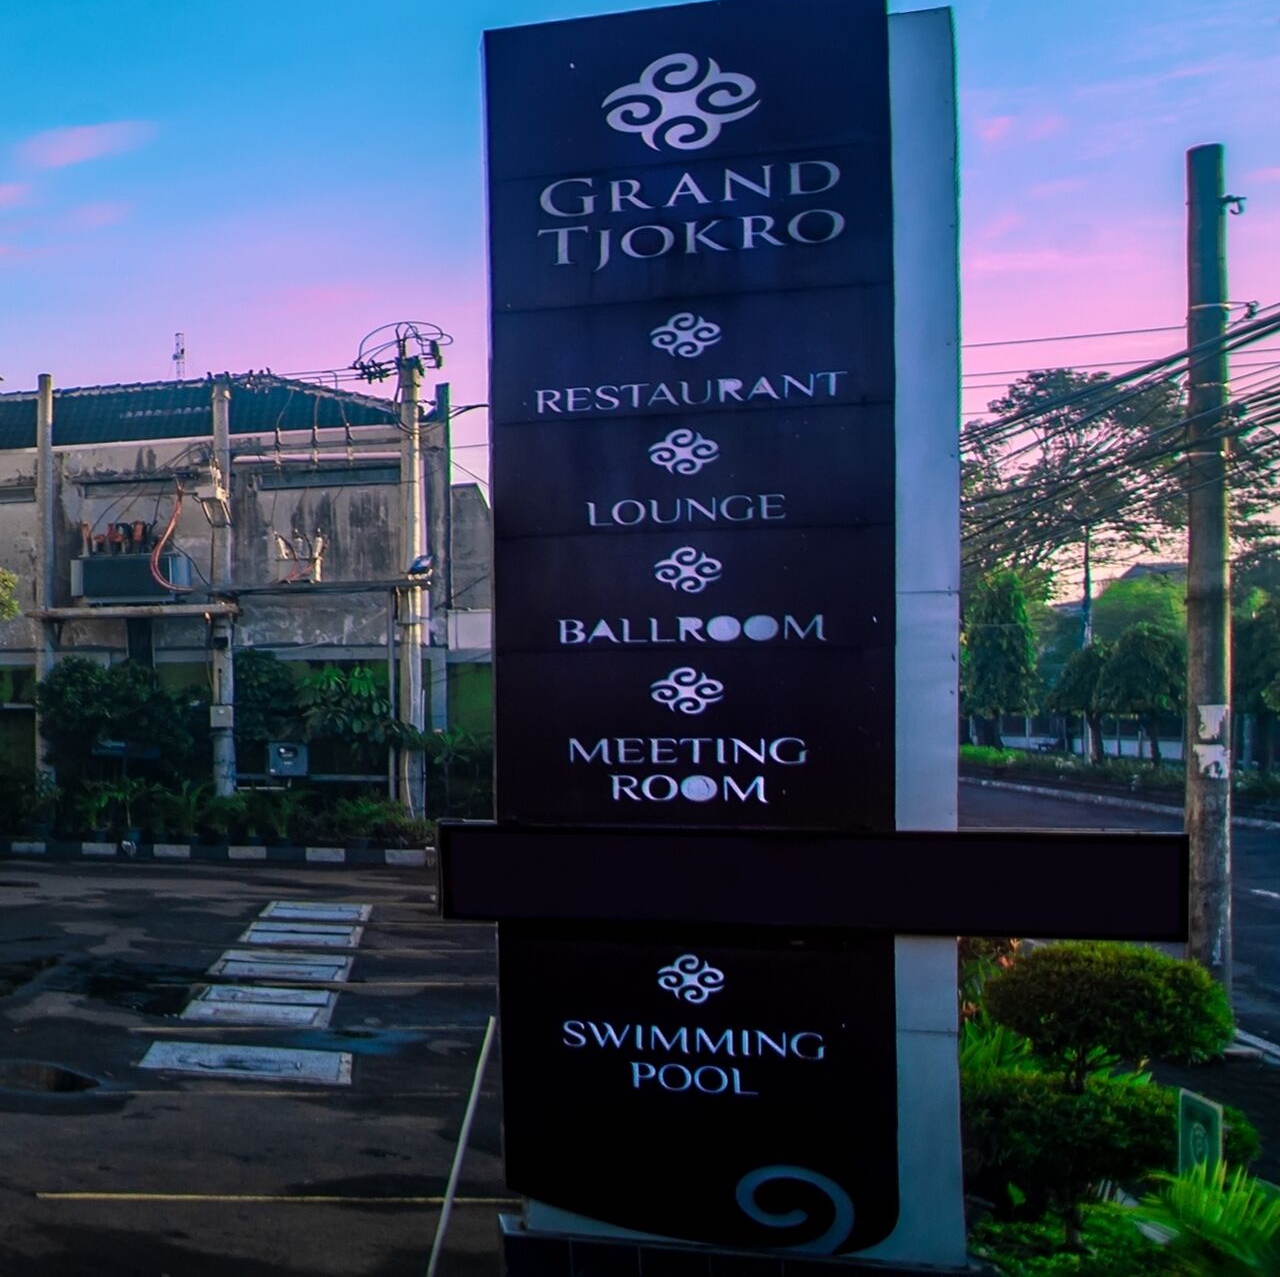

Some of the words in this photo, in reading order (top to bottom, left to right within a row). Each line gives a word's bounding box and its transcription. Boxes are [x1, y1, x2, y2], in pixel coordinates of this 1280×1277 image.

[539, 160, 842, 218] GRAND
[537, 209, 846, 271] TJOKRO
[535, 371, 848, 414] RESTAURANT
[586, 494, 787, 527] LOUNGE
[557, 614, 827, 644] BALLROOM
[569, 736, 808, 766] MEETING
[611, 773, 769, 804] ROOM
[563, 1020, 825, 1060] SWIMMING
[630, 1061, 759, 1095] POOL
